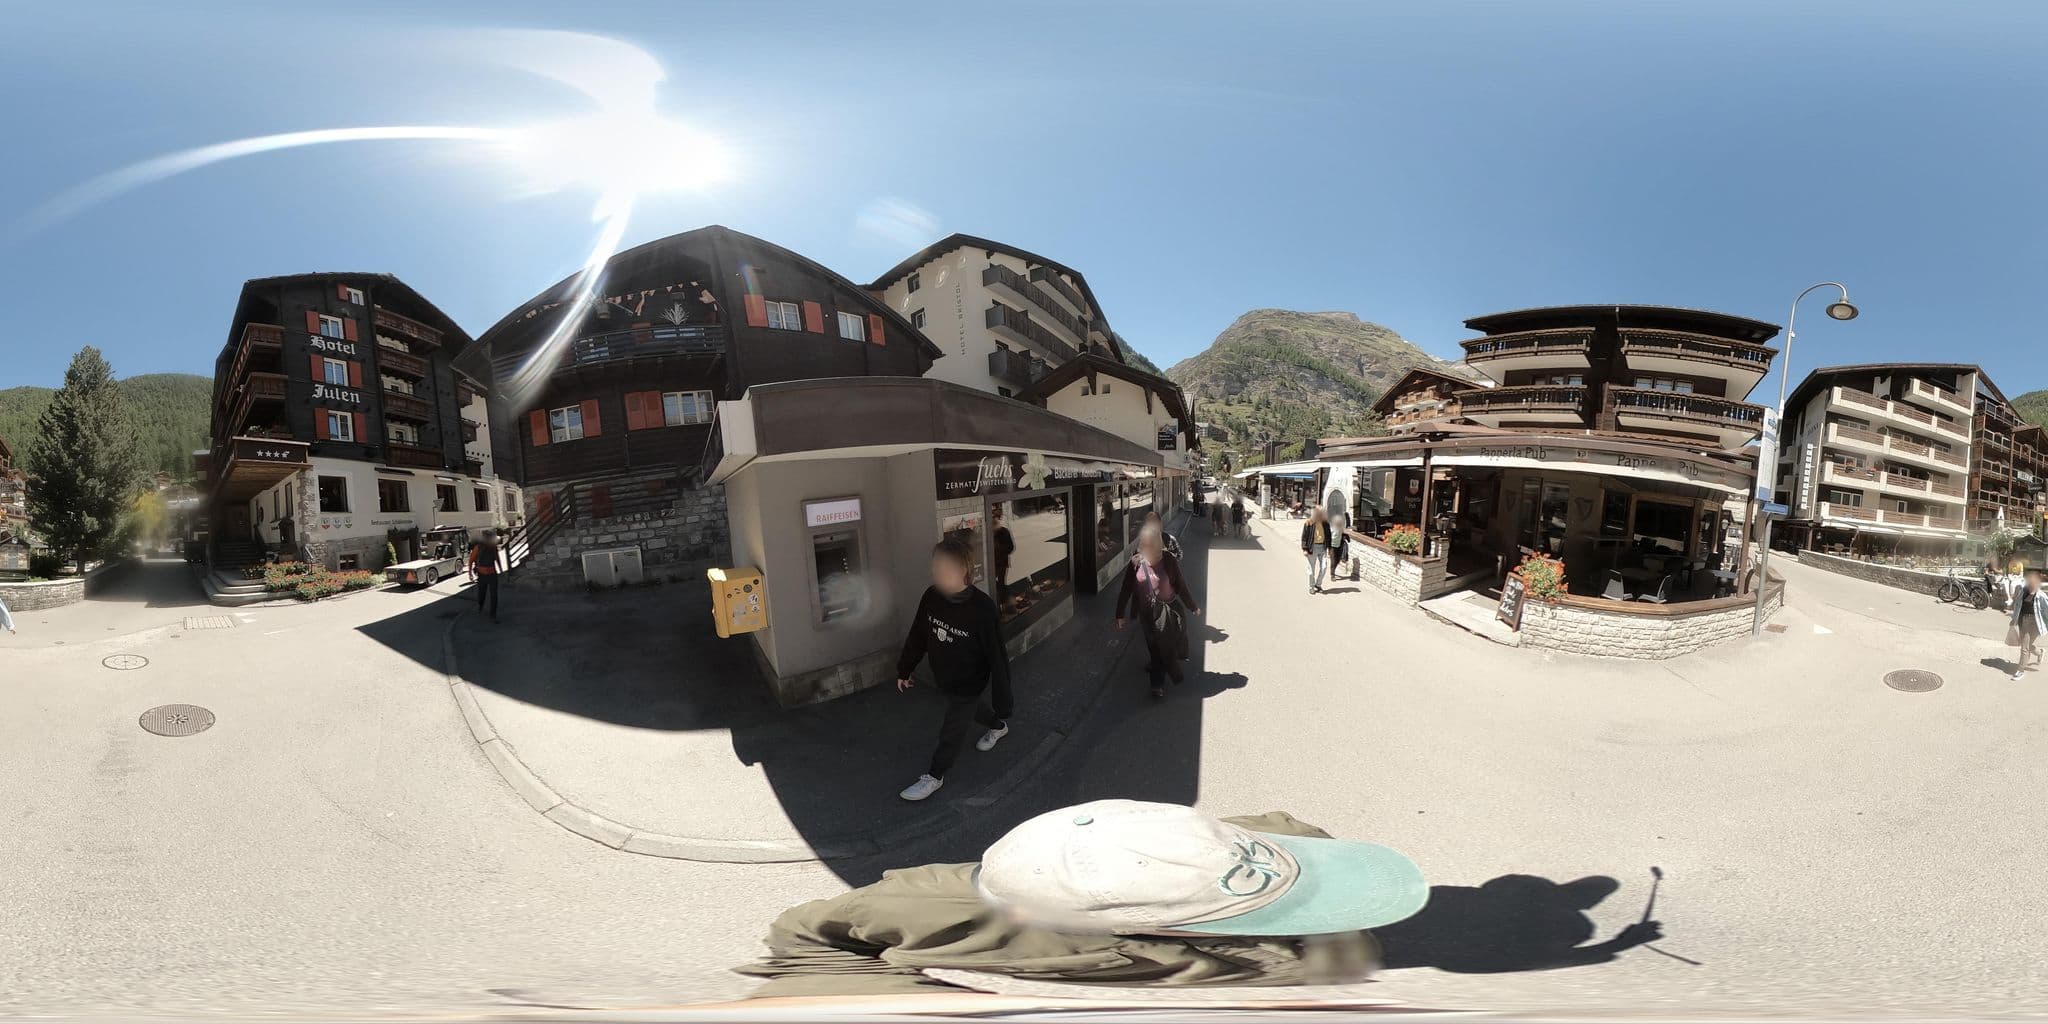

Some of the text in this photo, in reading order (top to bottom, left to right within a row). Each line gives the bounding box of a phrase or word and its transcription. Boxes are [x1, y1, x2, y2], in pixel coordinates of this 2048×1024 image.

[310, 335, 356, 355] Hotel
[312, 384, 360, 403] Julen
[1480, 446, 1547, 461] Papperla Pub
[971, 456, 1013, 494] fuchs
[1680, 461, 1699, 477] Pub
[945, 480, 976, 490] ZERMATT
[816, 511, 859, 522] RAIFFEISEN
[933, 618, 949, 630] POLO
